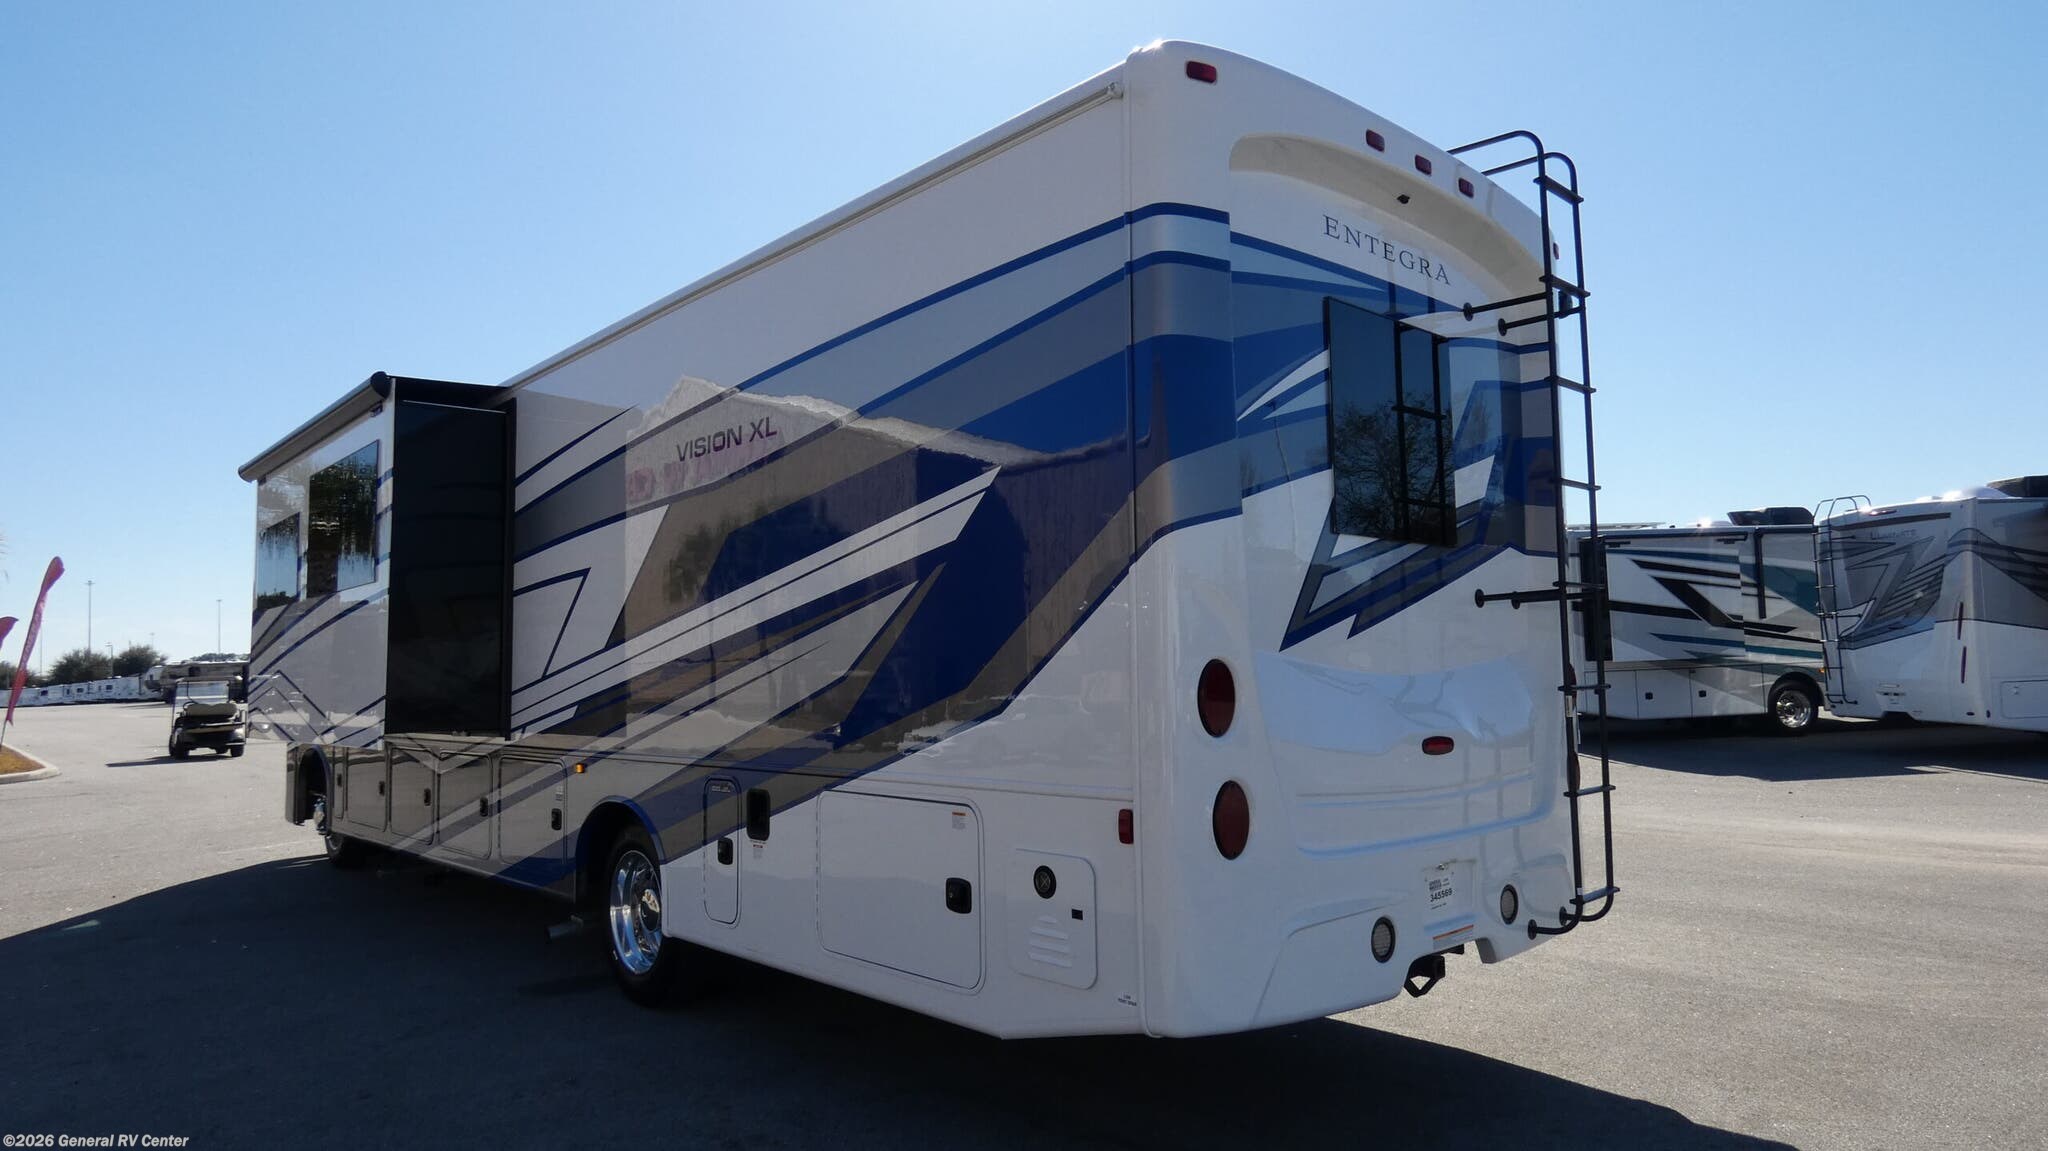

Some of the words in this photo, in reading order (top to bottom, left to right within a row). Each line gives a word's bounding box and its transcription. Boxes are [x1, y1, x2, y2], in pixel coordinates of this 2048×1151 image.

[1322, 214, 1451, 286] ENTEGRA
[676, 424, 742, 462] VISION
[749, 416, 778, 443] XL
[1430, 887, 1453, 902] 345569
